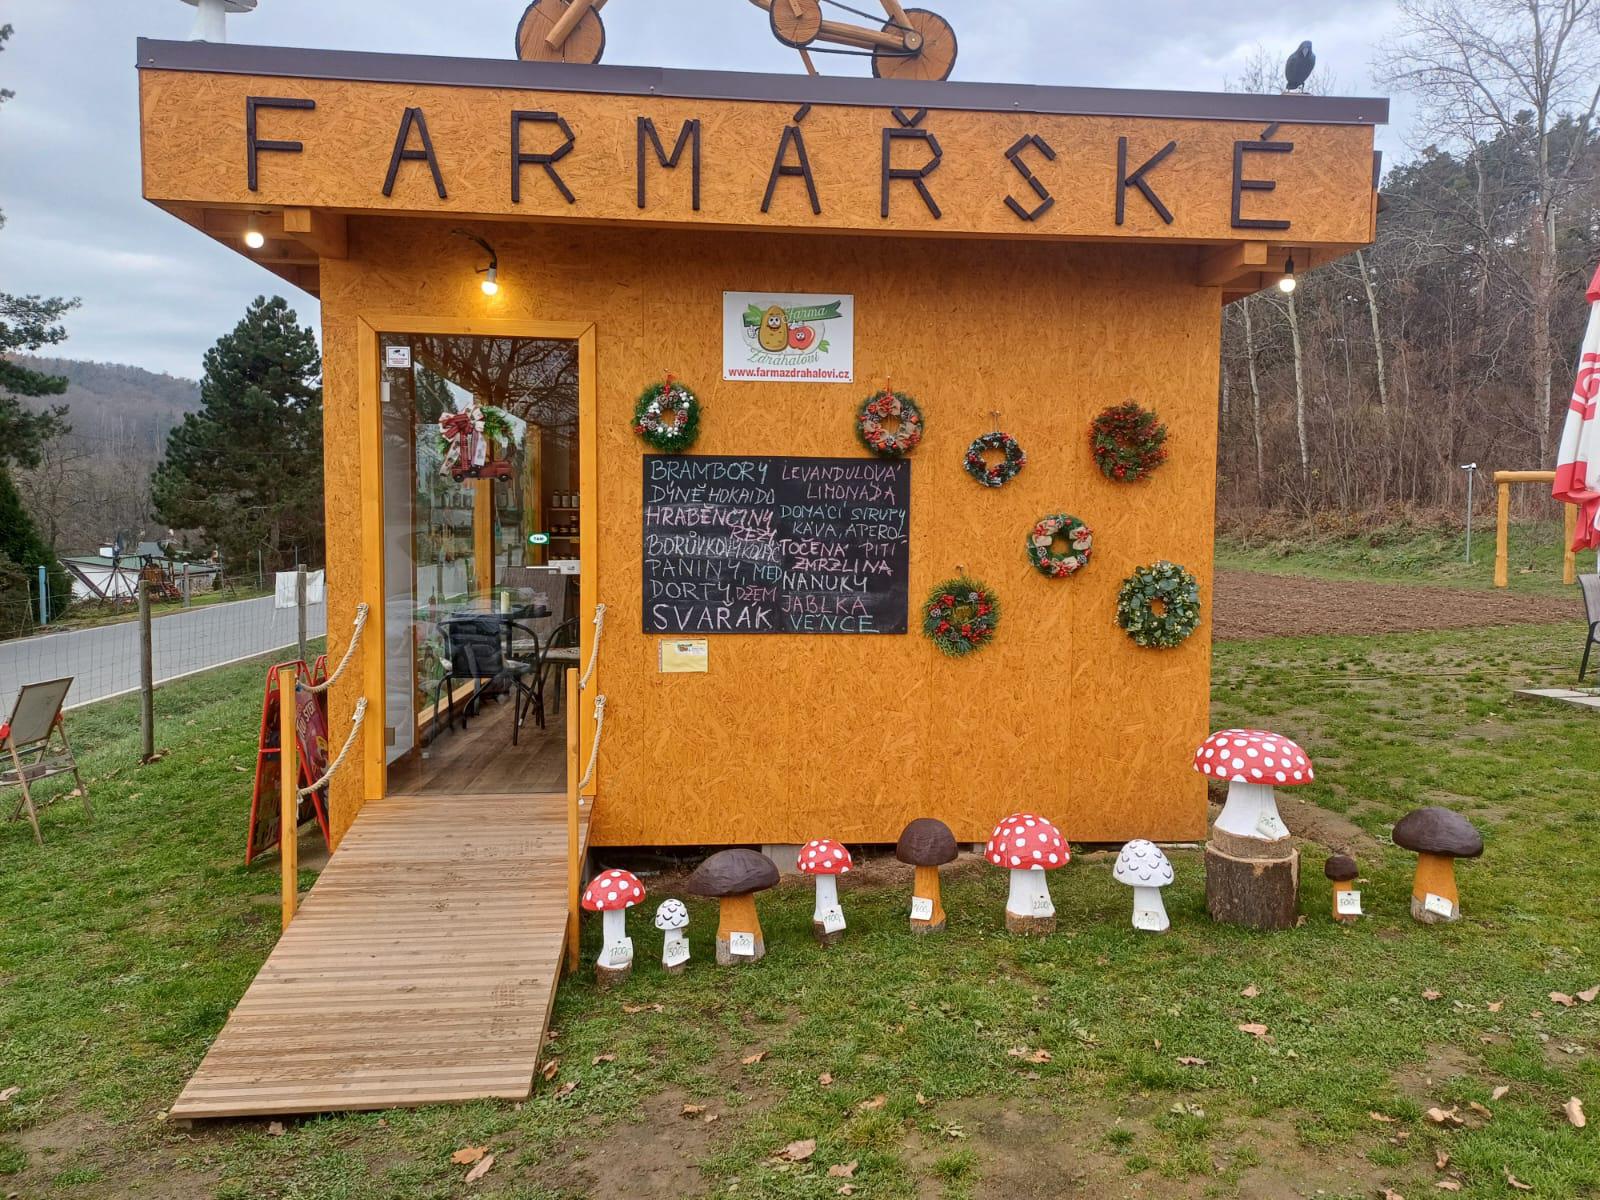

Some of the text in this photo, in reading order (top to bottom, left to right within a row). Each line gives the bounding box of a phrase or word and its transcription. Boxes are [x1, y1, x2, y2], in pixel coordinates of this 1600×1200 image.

[246, 96, 1294, 229] FARMÁŘSKÉ
[728, 366, 850, 379] www.farmazdrahalovi.cz
[651, 459, 768, 485] BRAMBORY
[782, 464, 901, 482] LEVANDULOVÁ
[648, 480, 775, 505] DÝNĚ HOKAIDO
[780, 501, 847, 519] DOMÁCÍ
[845, 523, 907, 540] APEROL
[779, 538, 849, 557] TOČENÁ
[753, 562, 782, 583] MED
[783, 570, 868, 593] NANUKY
[649, 579, 730, 603] DORTY
[653, 599, 773, 631] SVAŘÁK
[782, 595, 868, 617] JABLKA
[790, 613, 880, 633] VĚNCE
